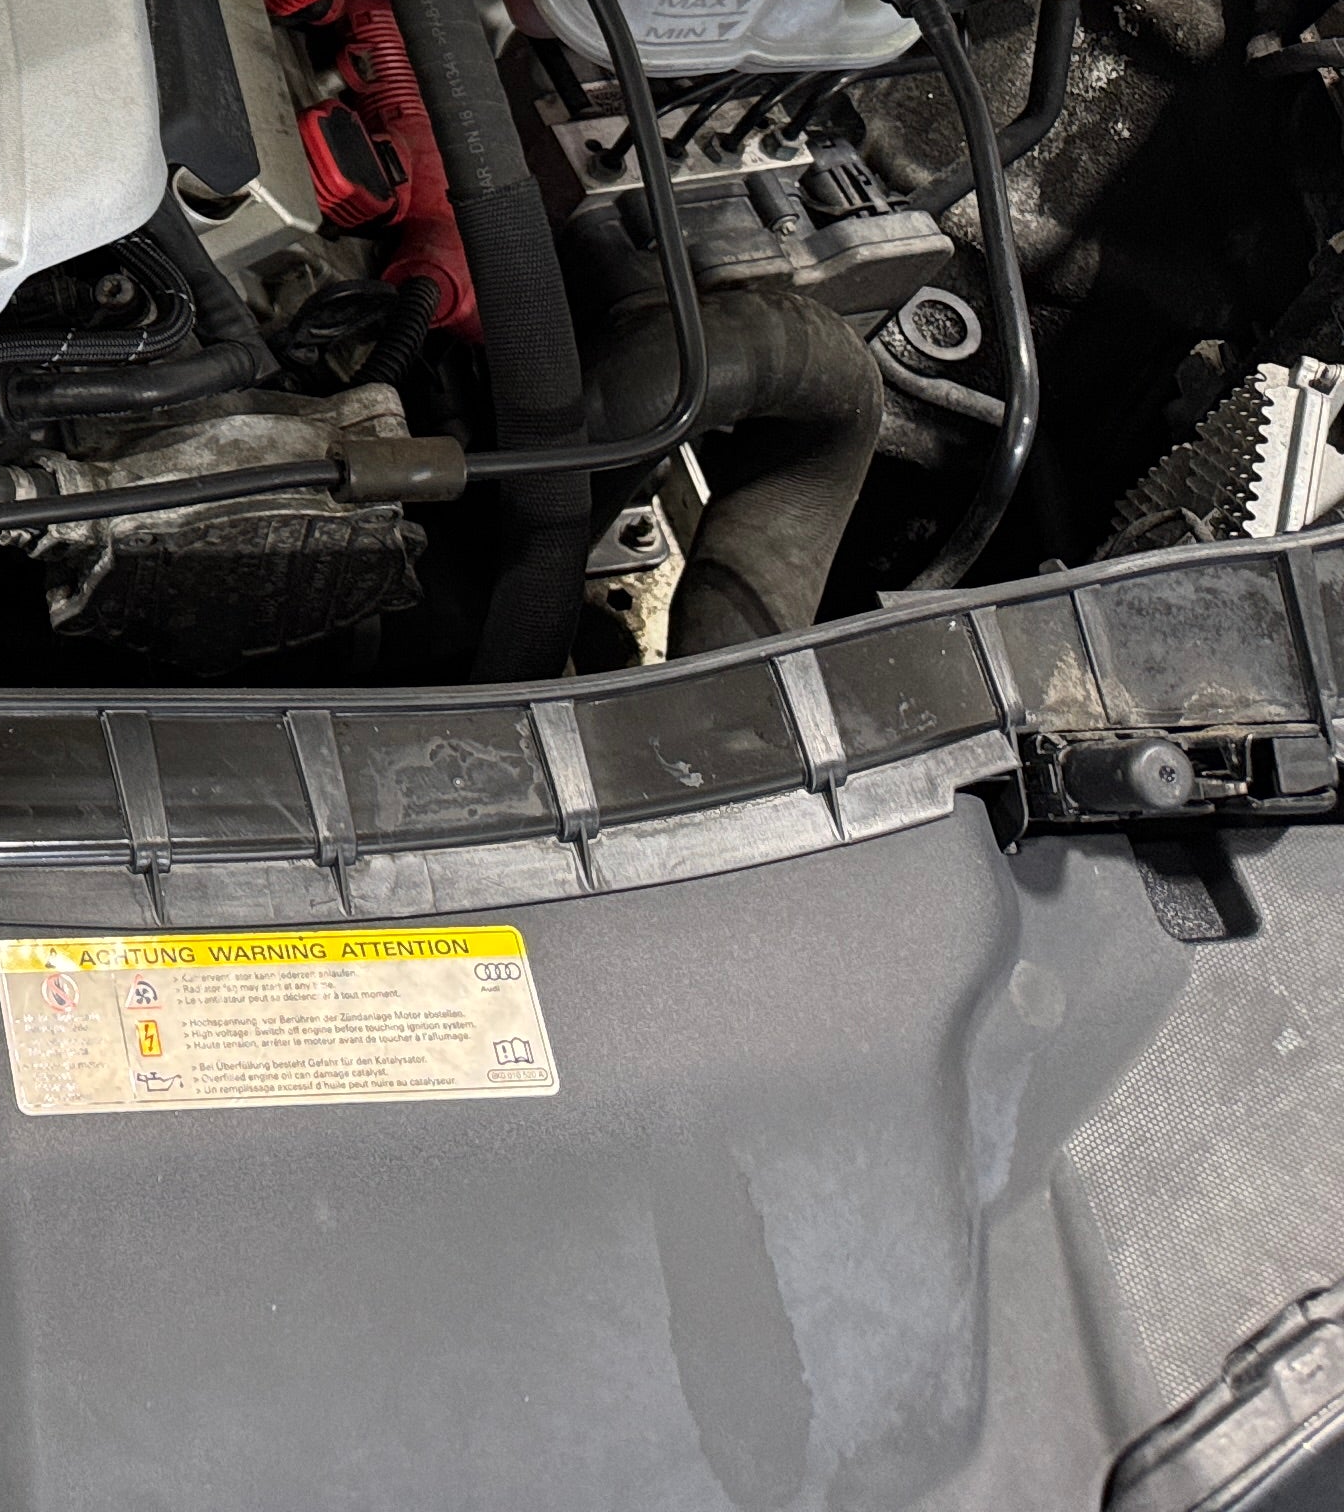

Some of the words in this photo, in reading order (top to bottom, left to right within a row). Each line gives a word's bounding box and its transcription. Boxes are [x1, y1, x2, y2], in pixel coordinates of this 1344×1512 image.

[646, 24, 707, 40] MIN
[443, 51, 467, 98] R134a
[465, 130, 484, 154] DN
[79, 946, 196, 967] ACHTUNG
[208, 942, 328, 963] WARNING
[341, 938, 470, 958] ATTENTION
[394, 1010, 421, 1020] Motor
[192, 1029, 213, 1040] High
[302, 1026, 333, 1037] engine
[334, 1023, 363, 1034] before
[365, 1022, 404, 1034] touching
[407, 1020, 440, 1033] ignition
[303, 1036, 336, 1046] moteur
[272, 1058, 306, 1069] besteht
[308, 1057, 339, 1068] Gefahr
[356, 1055, 373, 1066] den
[248, 1072, 279, 1083] engine
[280, 1070, 292, 1080] oil
[294, 1071, 311, 1079] can
[313, 1069, 350, 1080] damage
[204, 1085, 218, 1095] Un
